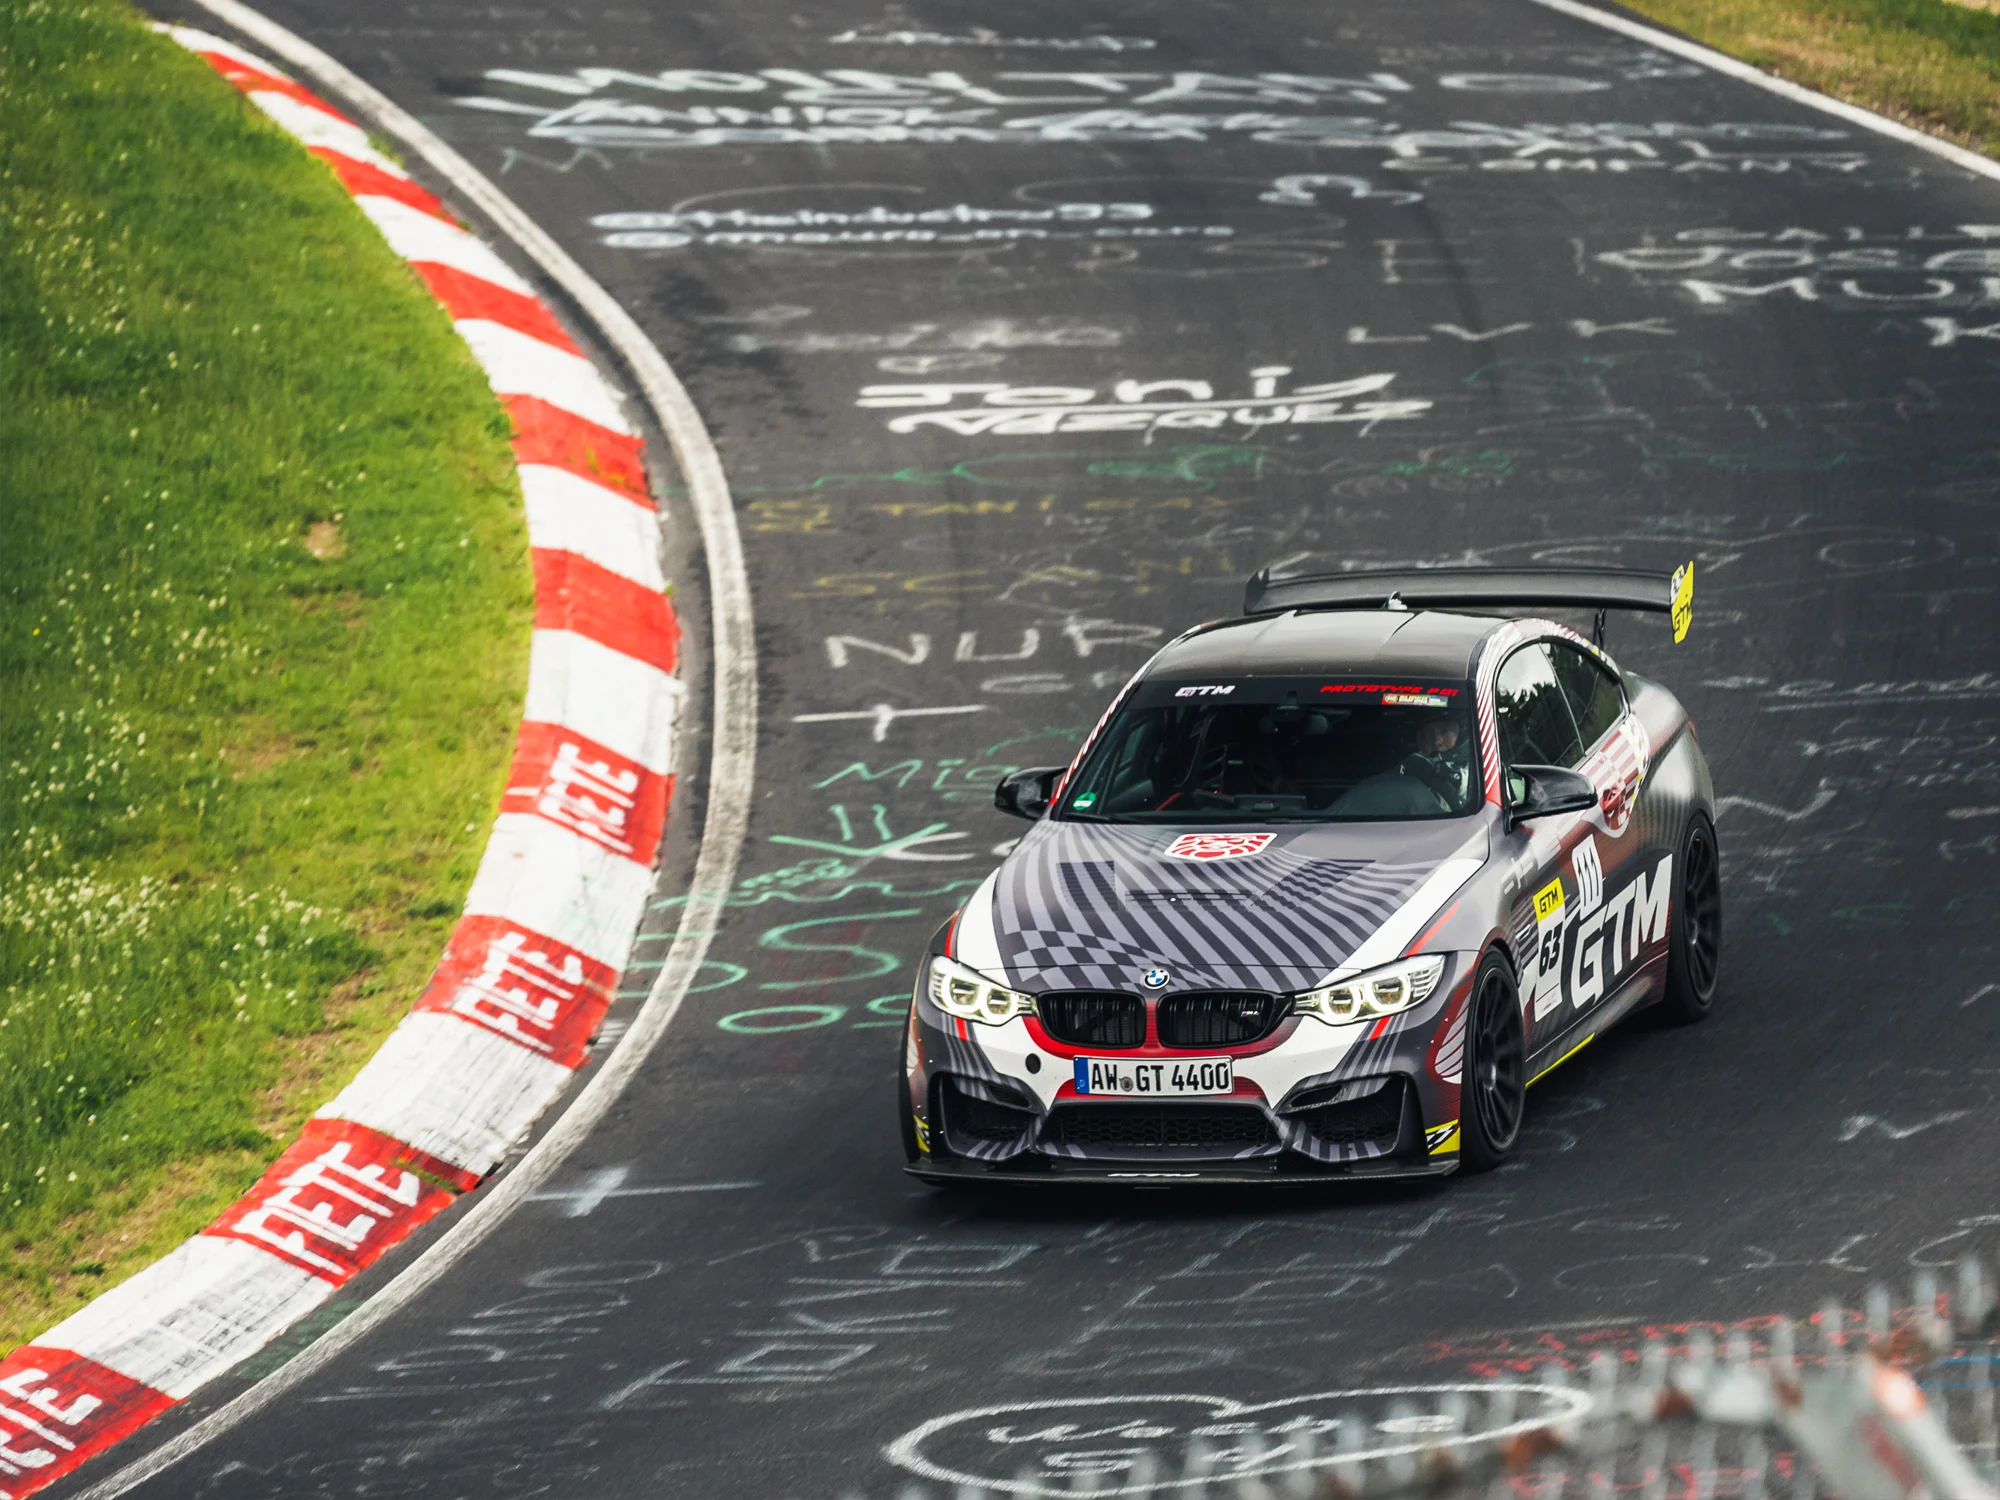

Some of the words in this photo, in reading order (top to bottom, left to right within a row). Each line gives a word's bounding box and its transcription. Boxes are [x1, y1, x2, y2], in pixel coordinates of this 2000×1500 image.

[1175, 685, 1236, 697] GTM
[1320, 685, 1423, 694] PROTOTYPE
[1539, 886, 1559, 914] GTM
[1571, 853, 1673, 1010] GTM
[1538, 920, 1565, 978] 63
[1091, 1063, 1118, 1091] AW
[1136, 1064, 1164, 1092] GT
[1172, 1062, 1230, 1091] 4400
